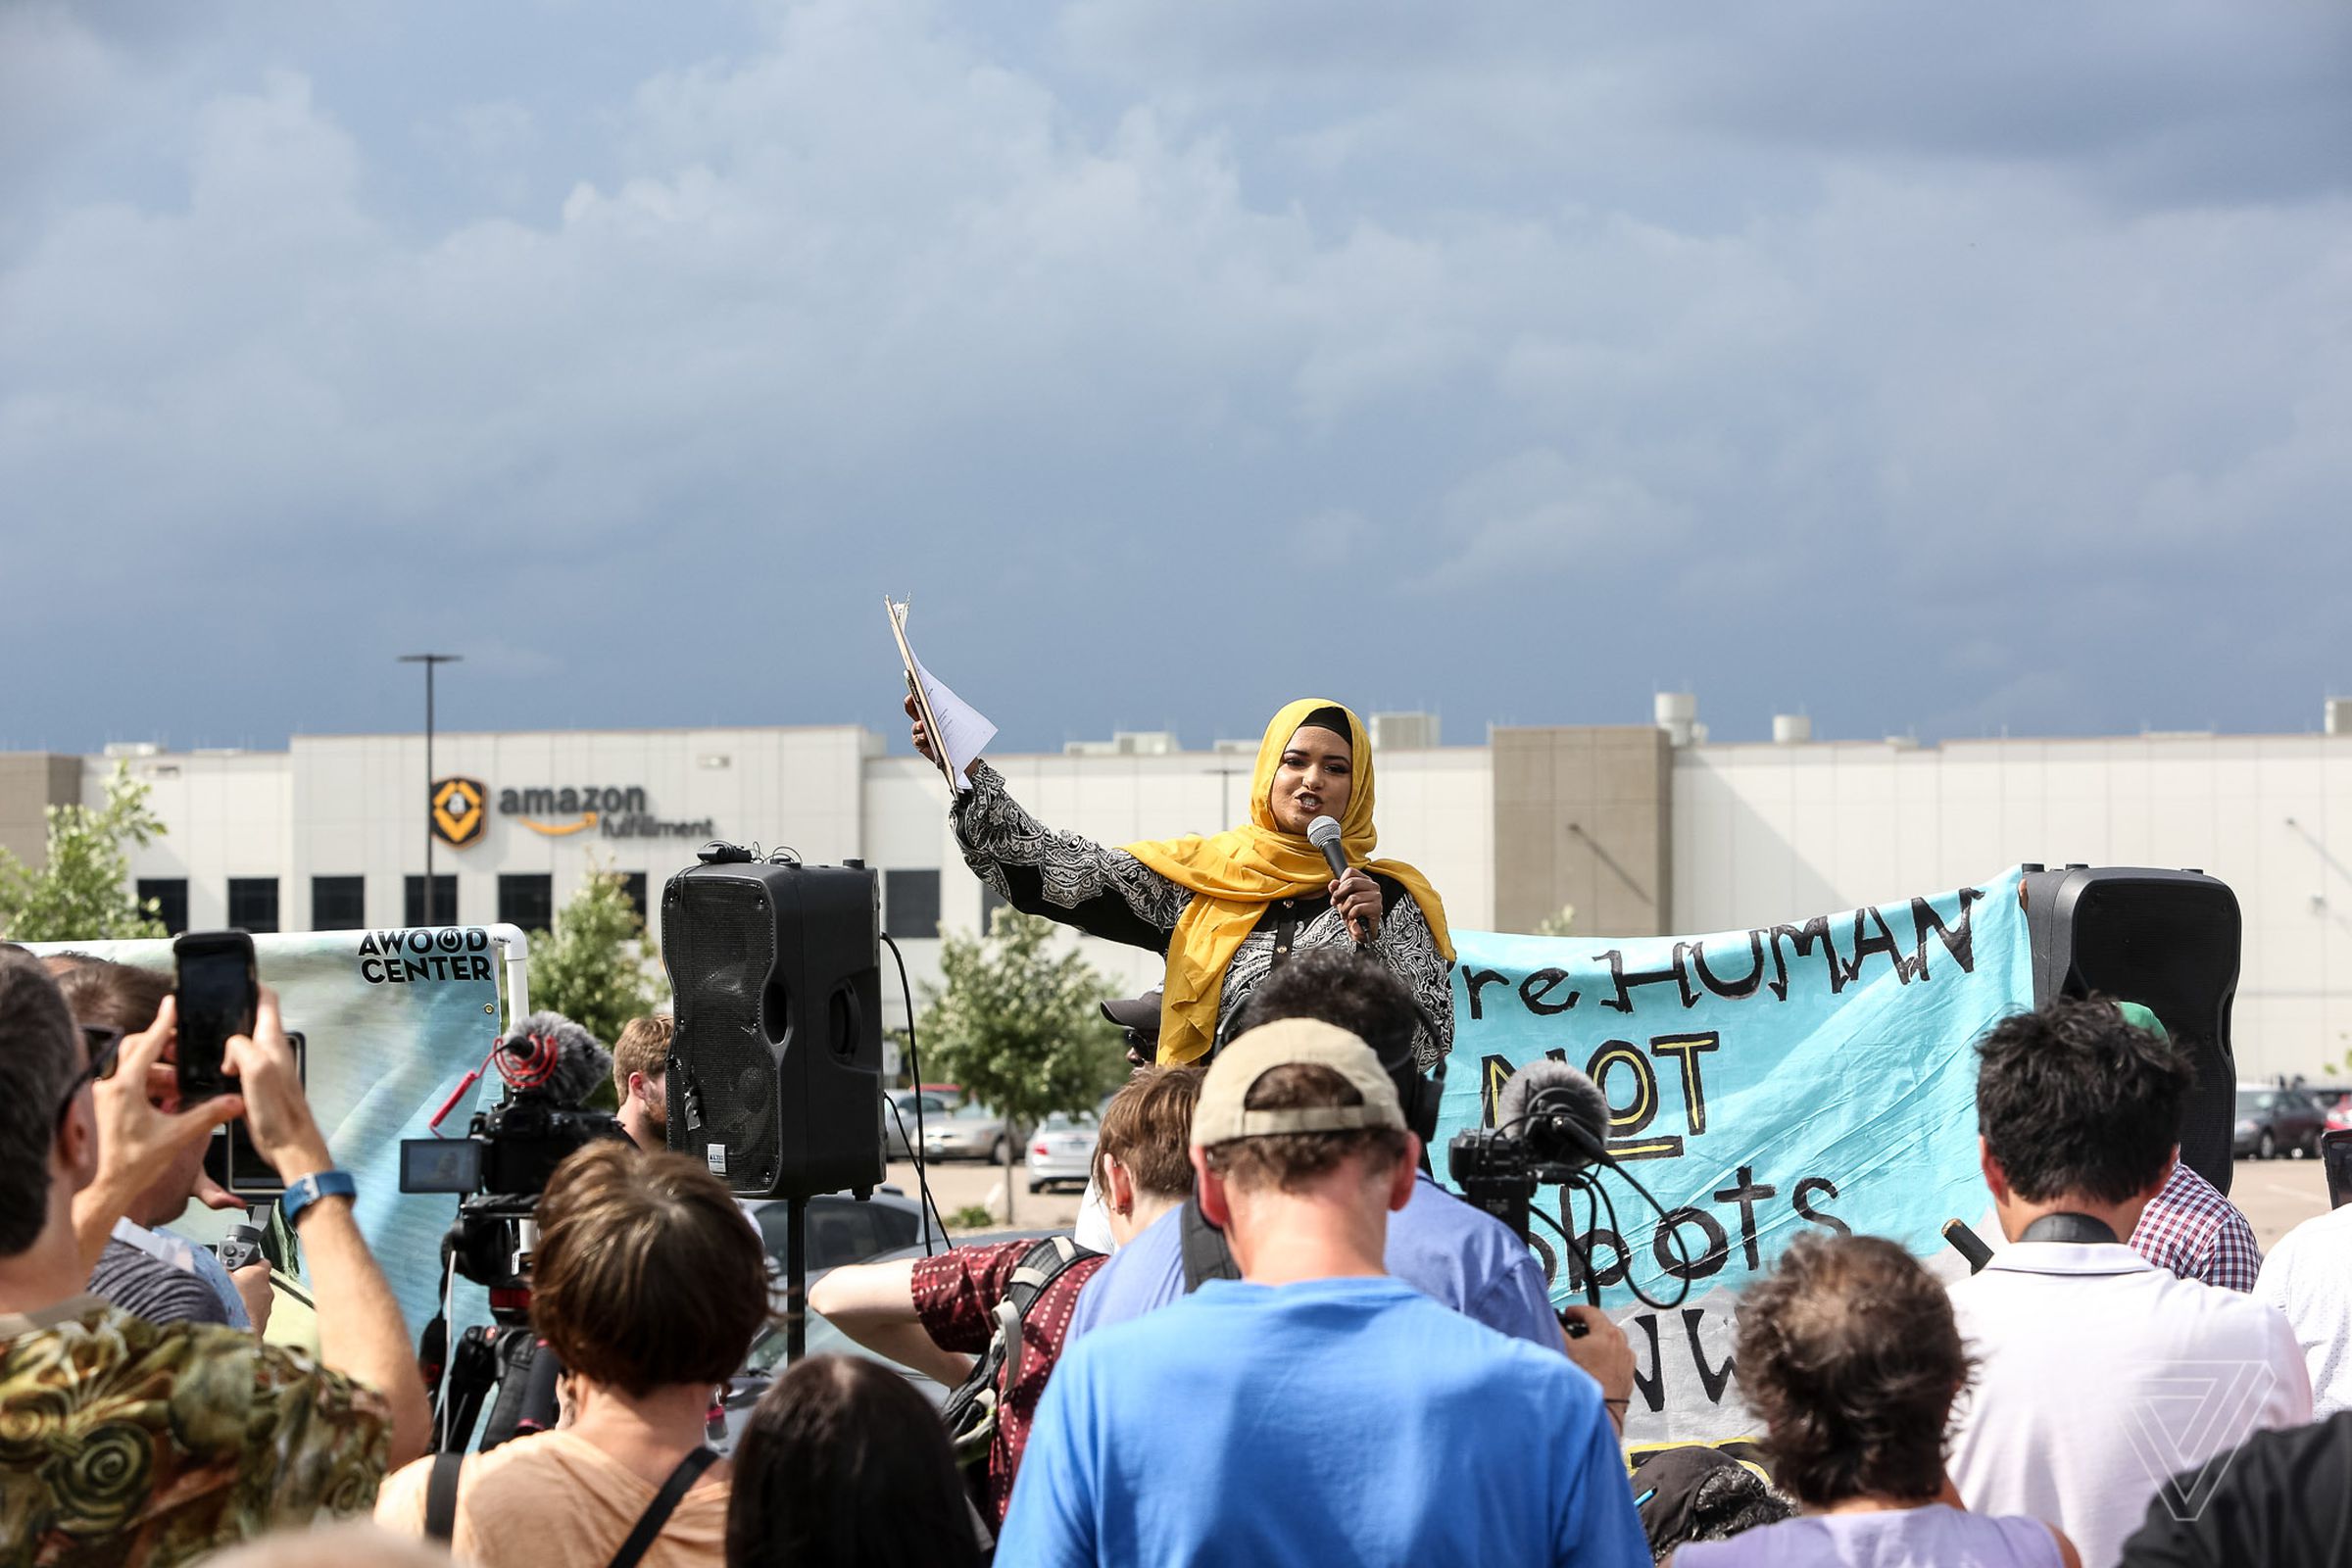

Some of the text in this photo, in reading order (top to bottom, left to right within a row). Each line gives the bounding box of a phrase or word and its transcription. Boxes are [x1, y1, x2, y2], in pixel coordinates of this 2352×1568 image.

[499, 783, 647, 814] amazon
[358, 928, 489, 956] AWOOD
[1592, 886, 1985, 1014] HUMAN
[361, 955, 493, 984] CENTER
